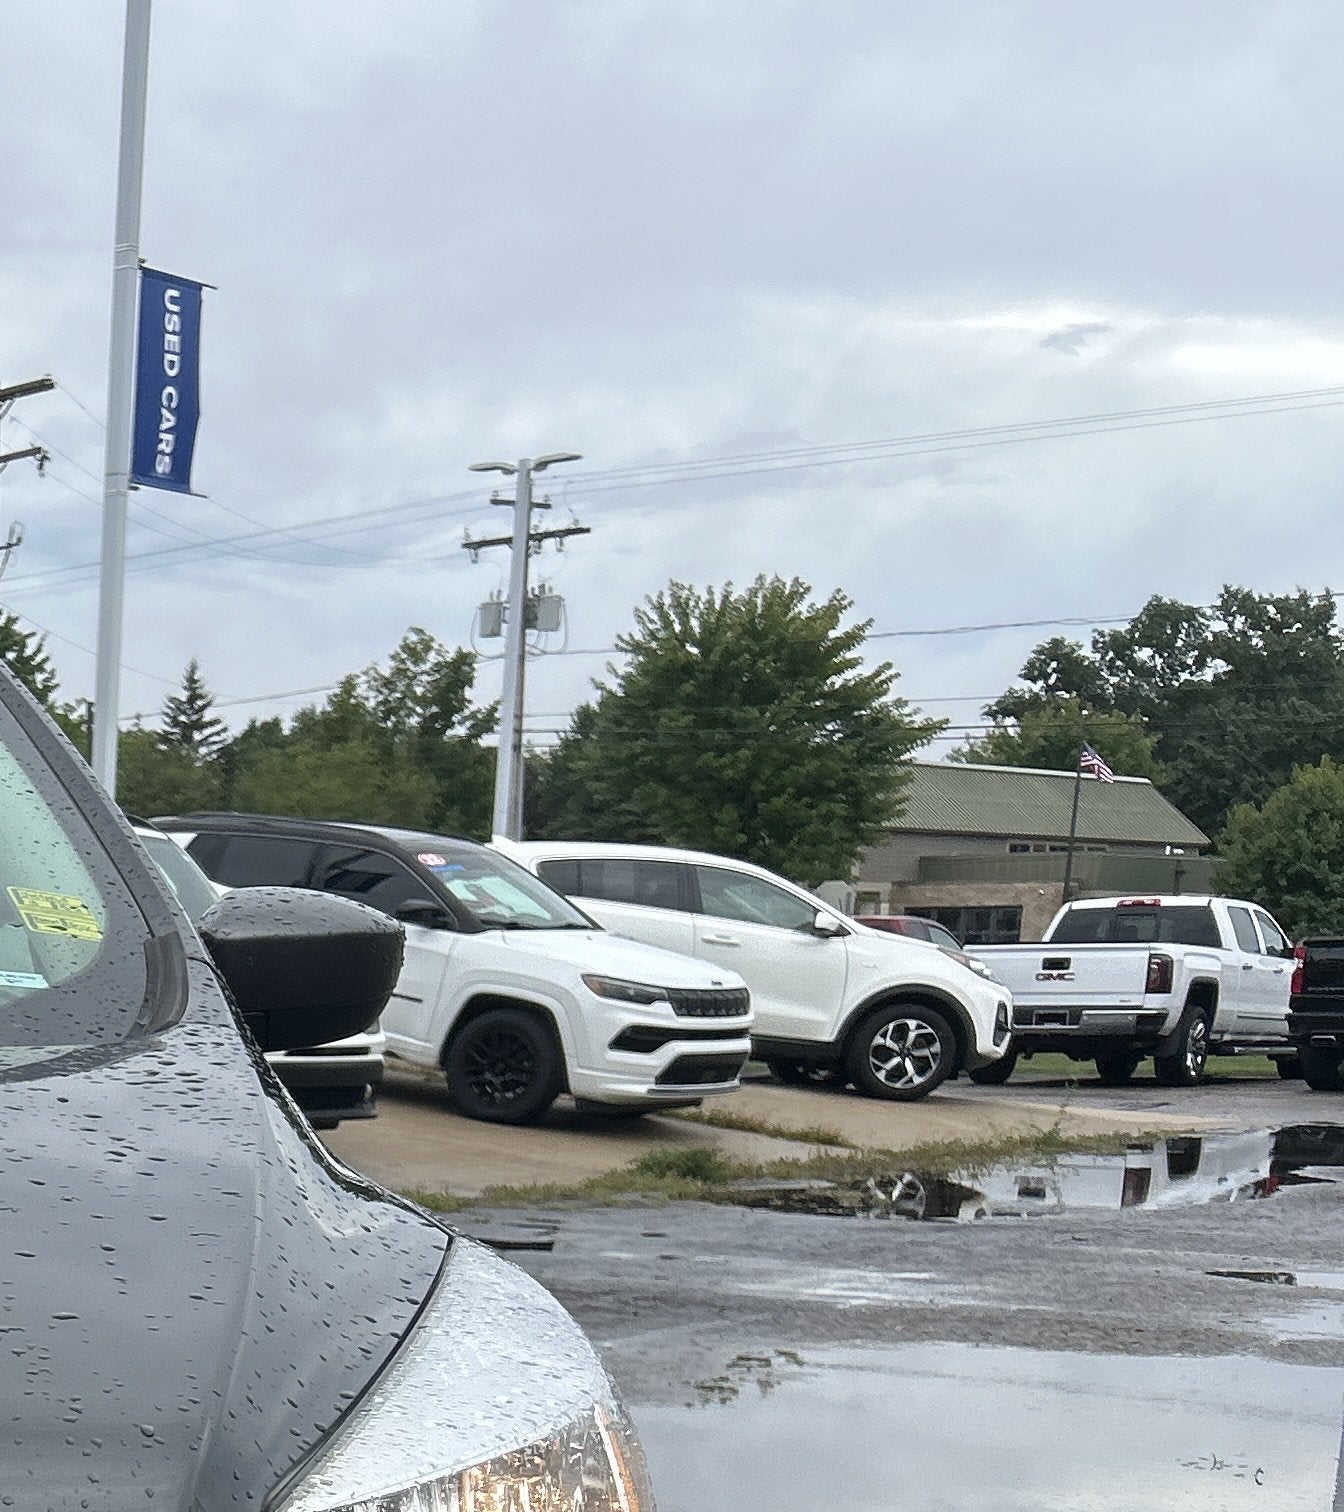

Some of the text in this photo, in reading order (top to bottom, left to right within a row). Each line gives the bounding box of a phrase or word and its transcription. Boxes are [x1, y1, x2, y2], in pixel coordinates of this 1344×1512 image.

[154, 288, 182, 475] USED CARS
[1035, 972, 1075, 981] GMC
